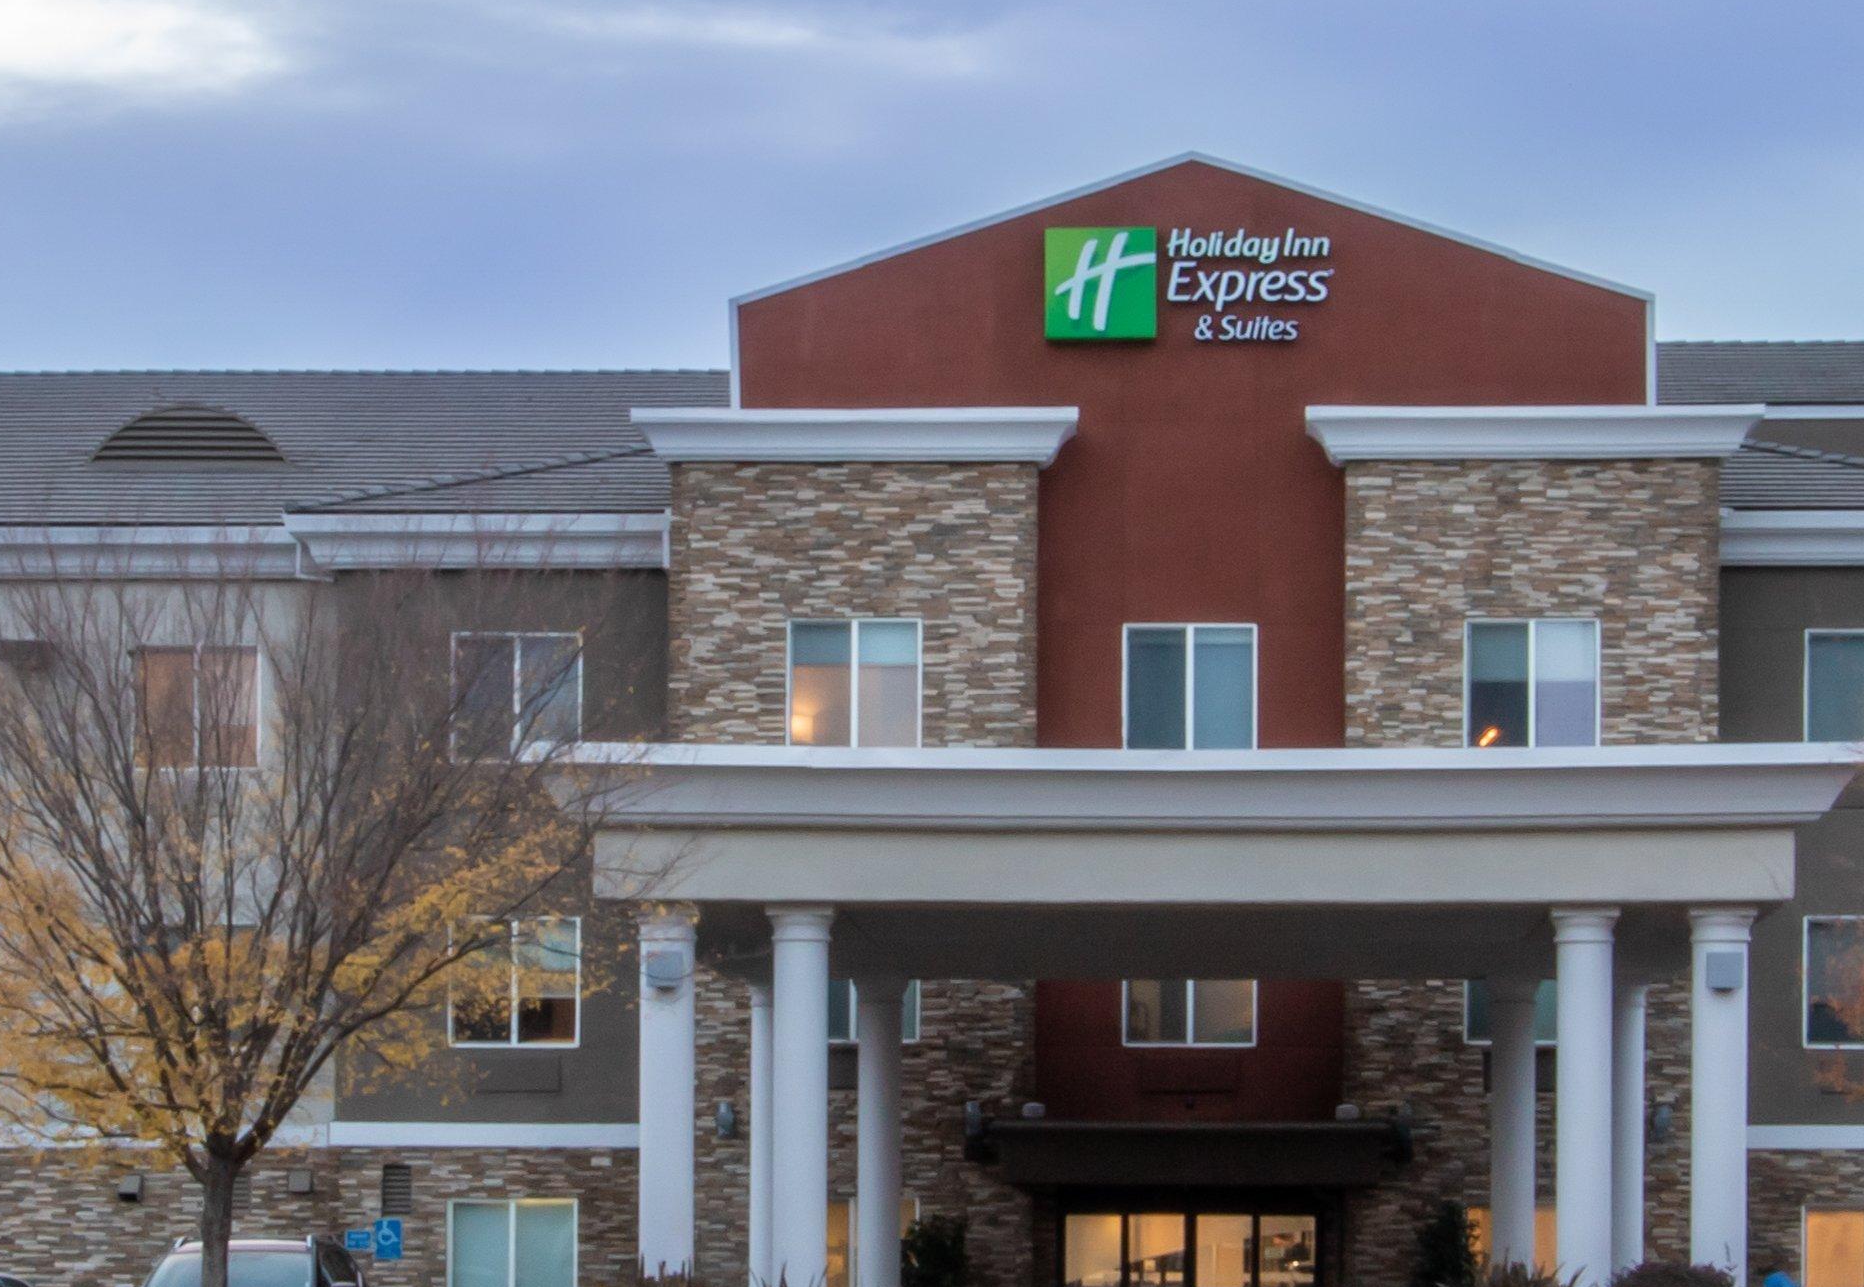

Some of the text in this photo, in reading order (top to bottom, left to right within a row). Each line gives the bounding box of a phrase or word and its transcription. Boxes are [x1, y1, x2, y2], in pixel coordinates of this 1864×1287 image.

[1167, 227, 1330, 264] Holiday Inn
[1166, 261, 1331, 313] Express
[1194, 314, 1299, 341] & Suites
